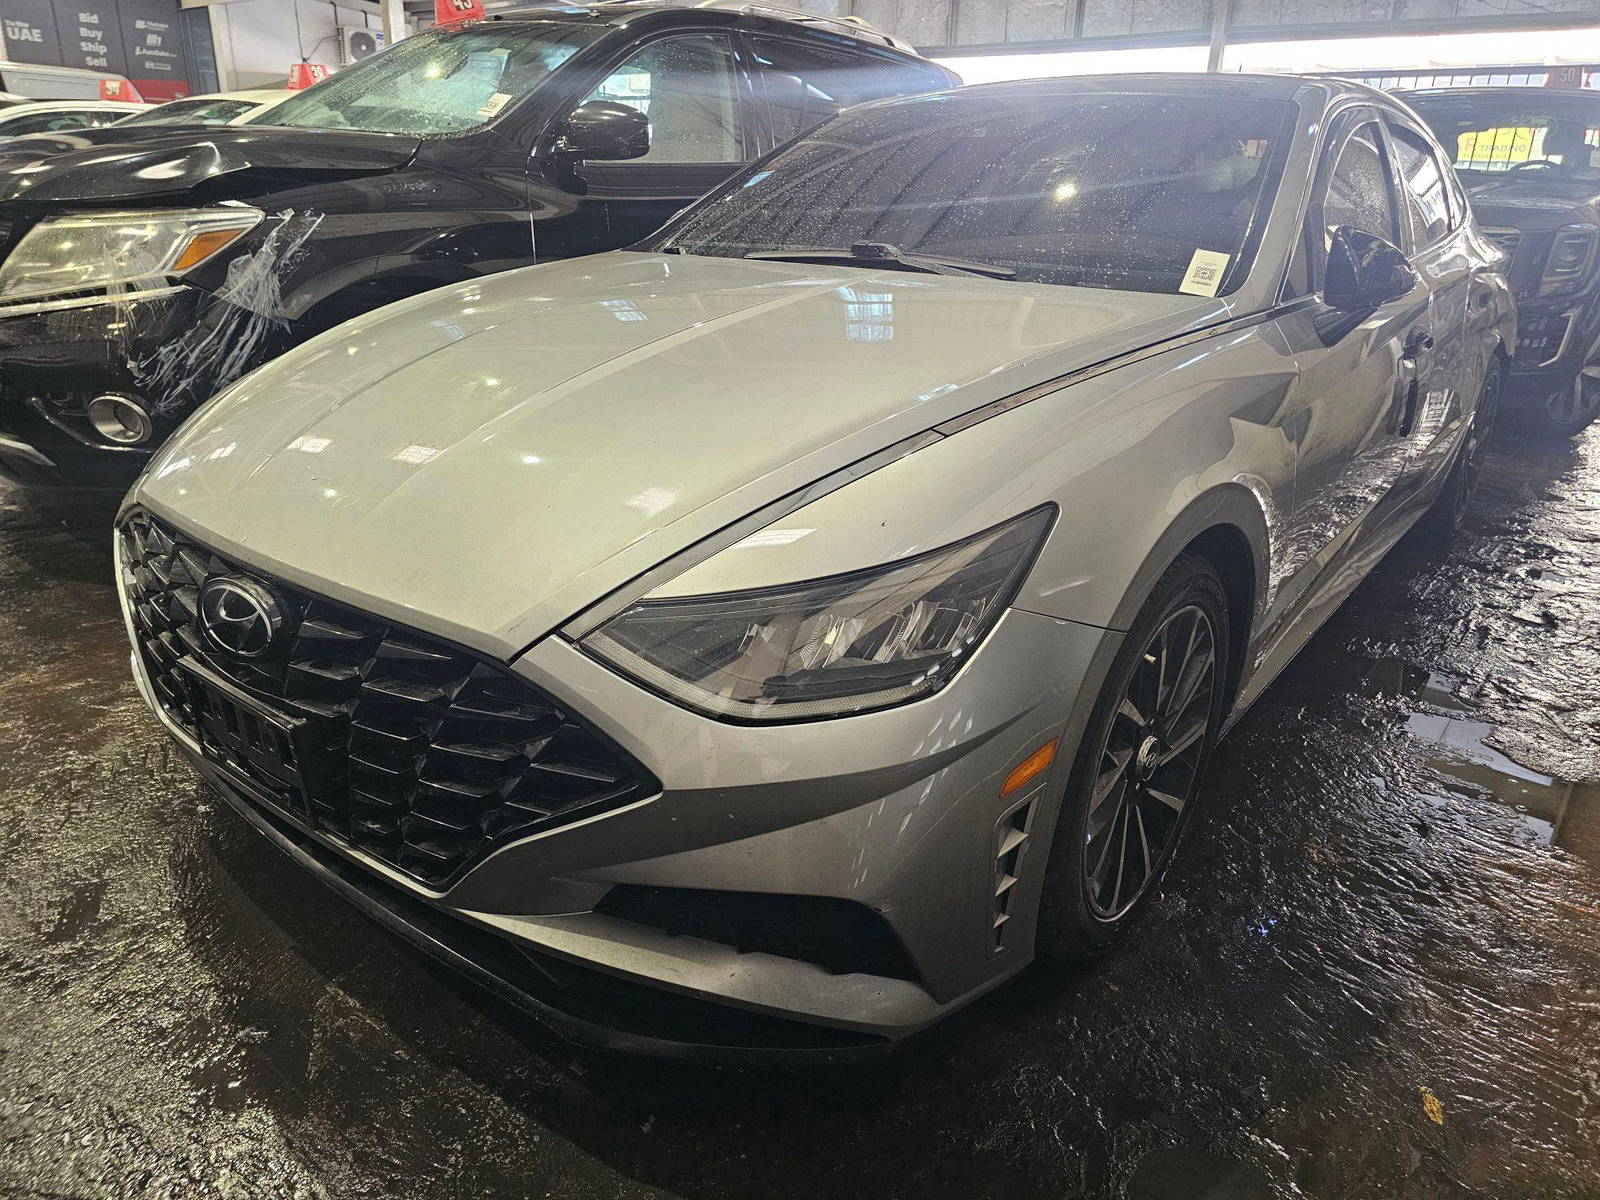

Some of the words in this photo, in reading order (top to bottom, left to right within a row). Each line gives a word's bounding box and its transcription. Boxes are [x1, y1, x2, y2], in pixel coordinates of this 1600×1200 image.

[78, 12, 99, 24] Bid
[6, 26, 43, 43] UAE
[79, 27, 103, 41] Buy
[79, 41, 107, 56] Ship
[85, 56, 108, 67] Sell
[1559, 67, 1575, 82] 50
